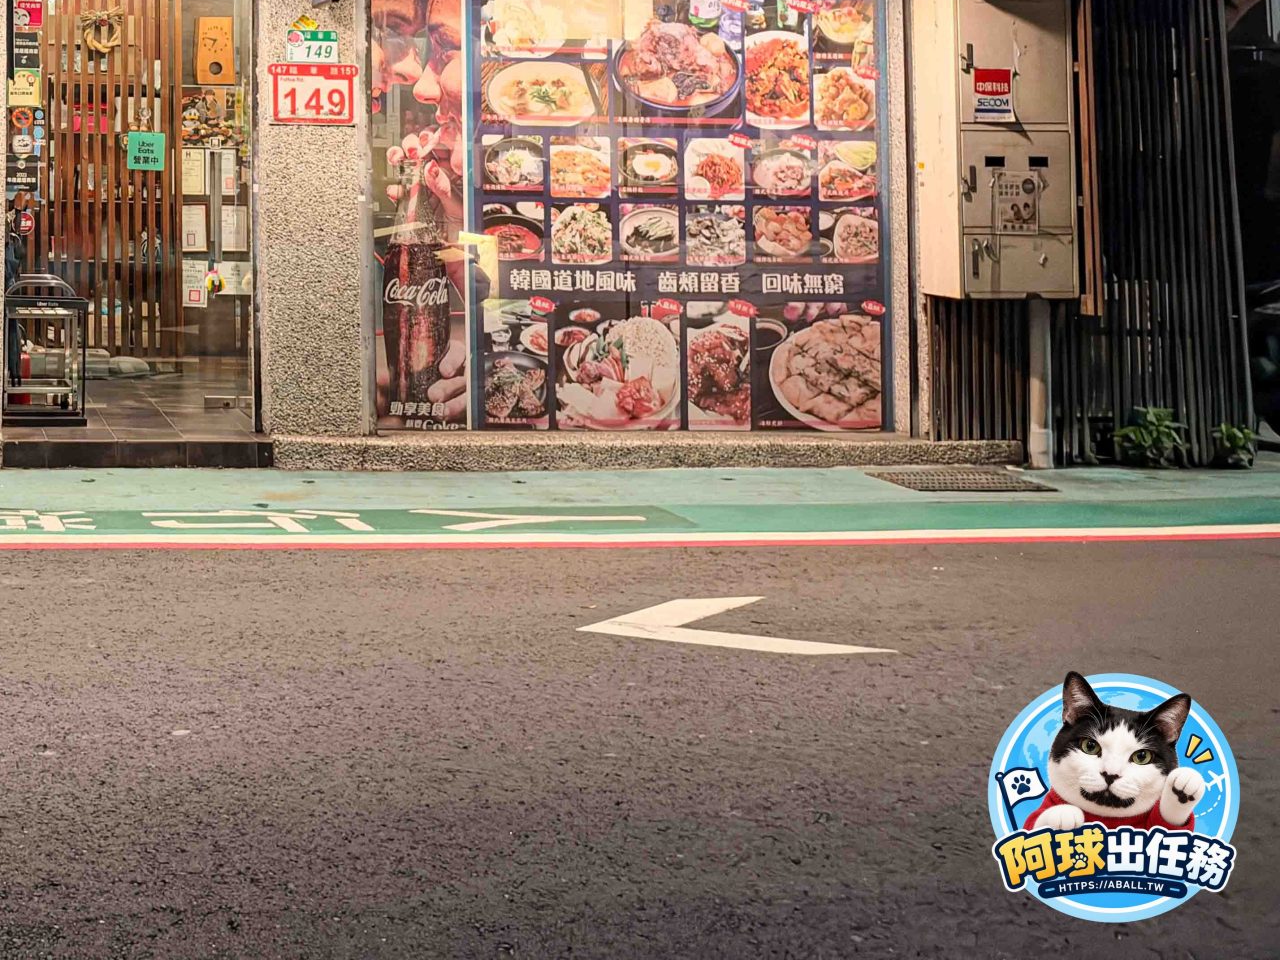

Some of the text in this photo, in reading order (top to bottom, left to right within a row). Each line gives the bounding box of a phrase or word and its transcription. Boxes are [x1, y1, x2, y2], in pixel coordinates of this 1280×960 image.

[305, 45, 333, 58] 149
[271, 66, 287, 74] 147
[340, 66, 356, 75] 151
[284, 88, 345, 116] 149
[977, 97, 1009, 107] SECOM
[510, 269, 844, 295] 韓國道地風味 齒頰留香 回味無窮
